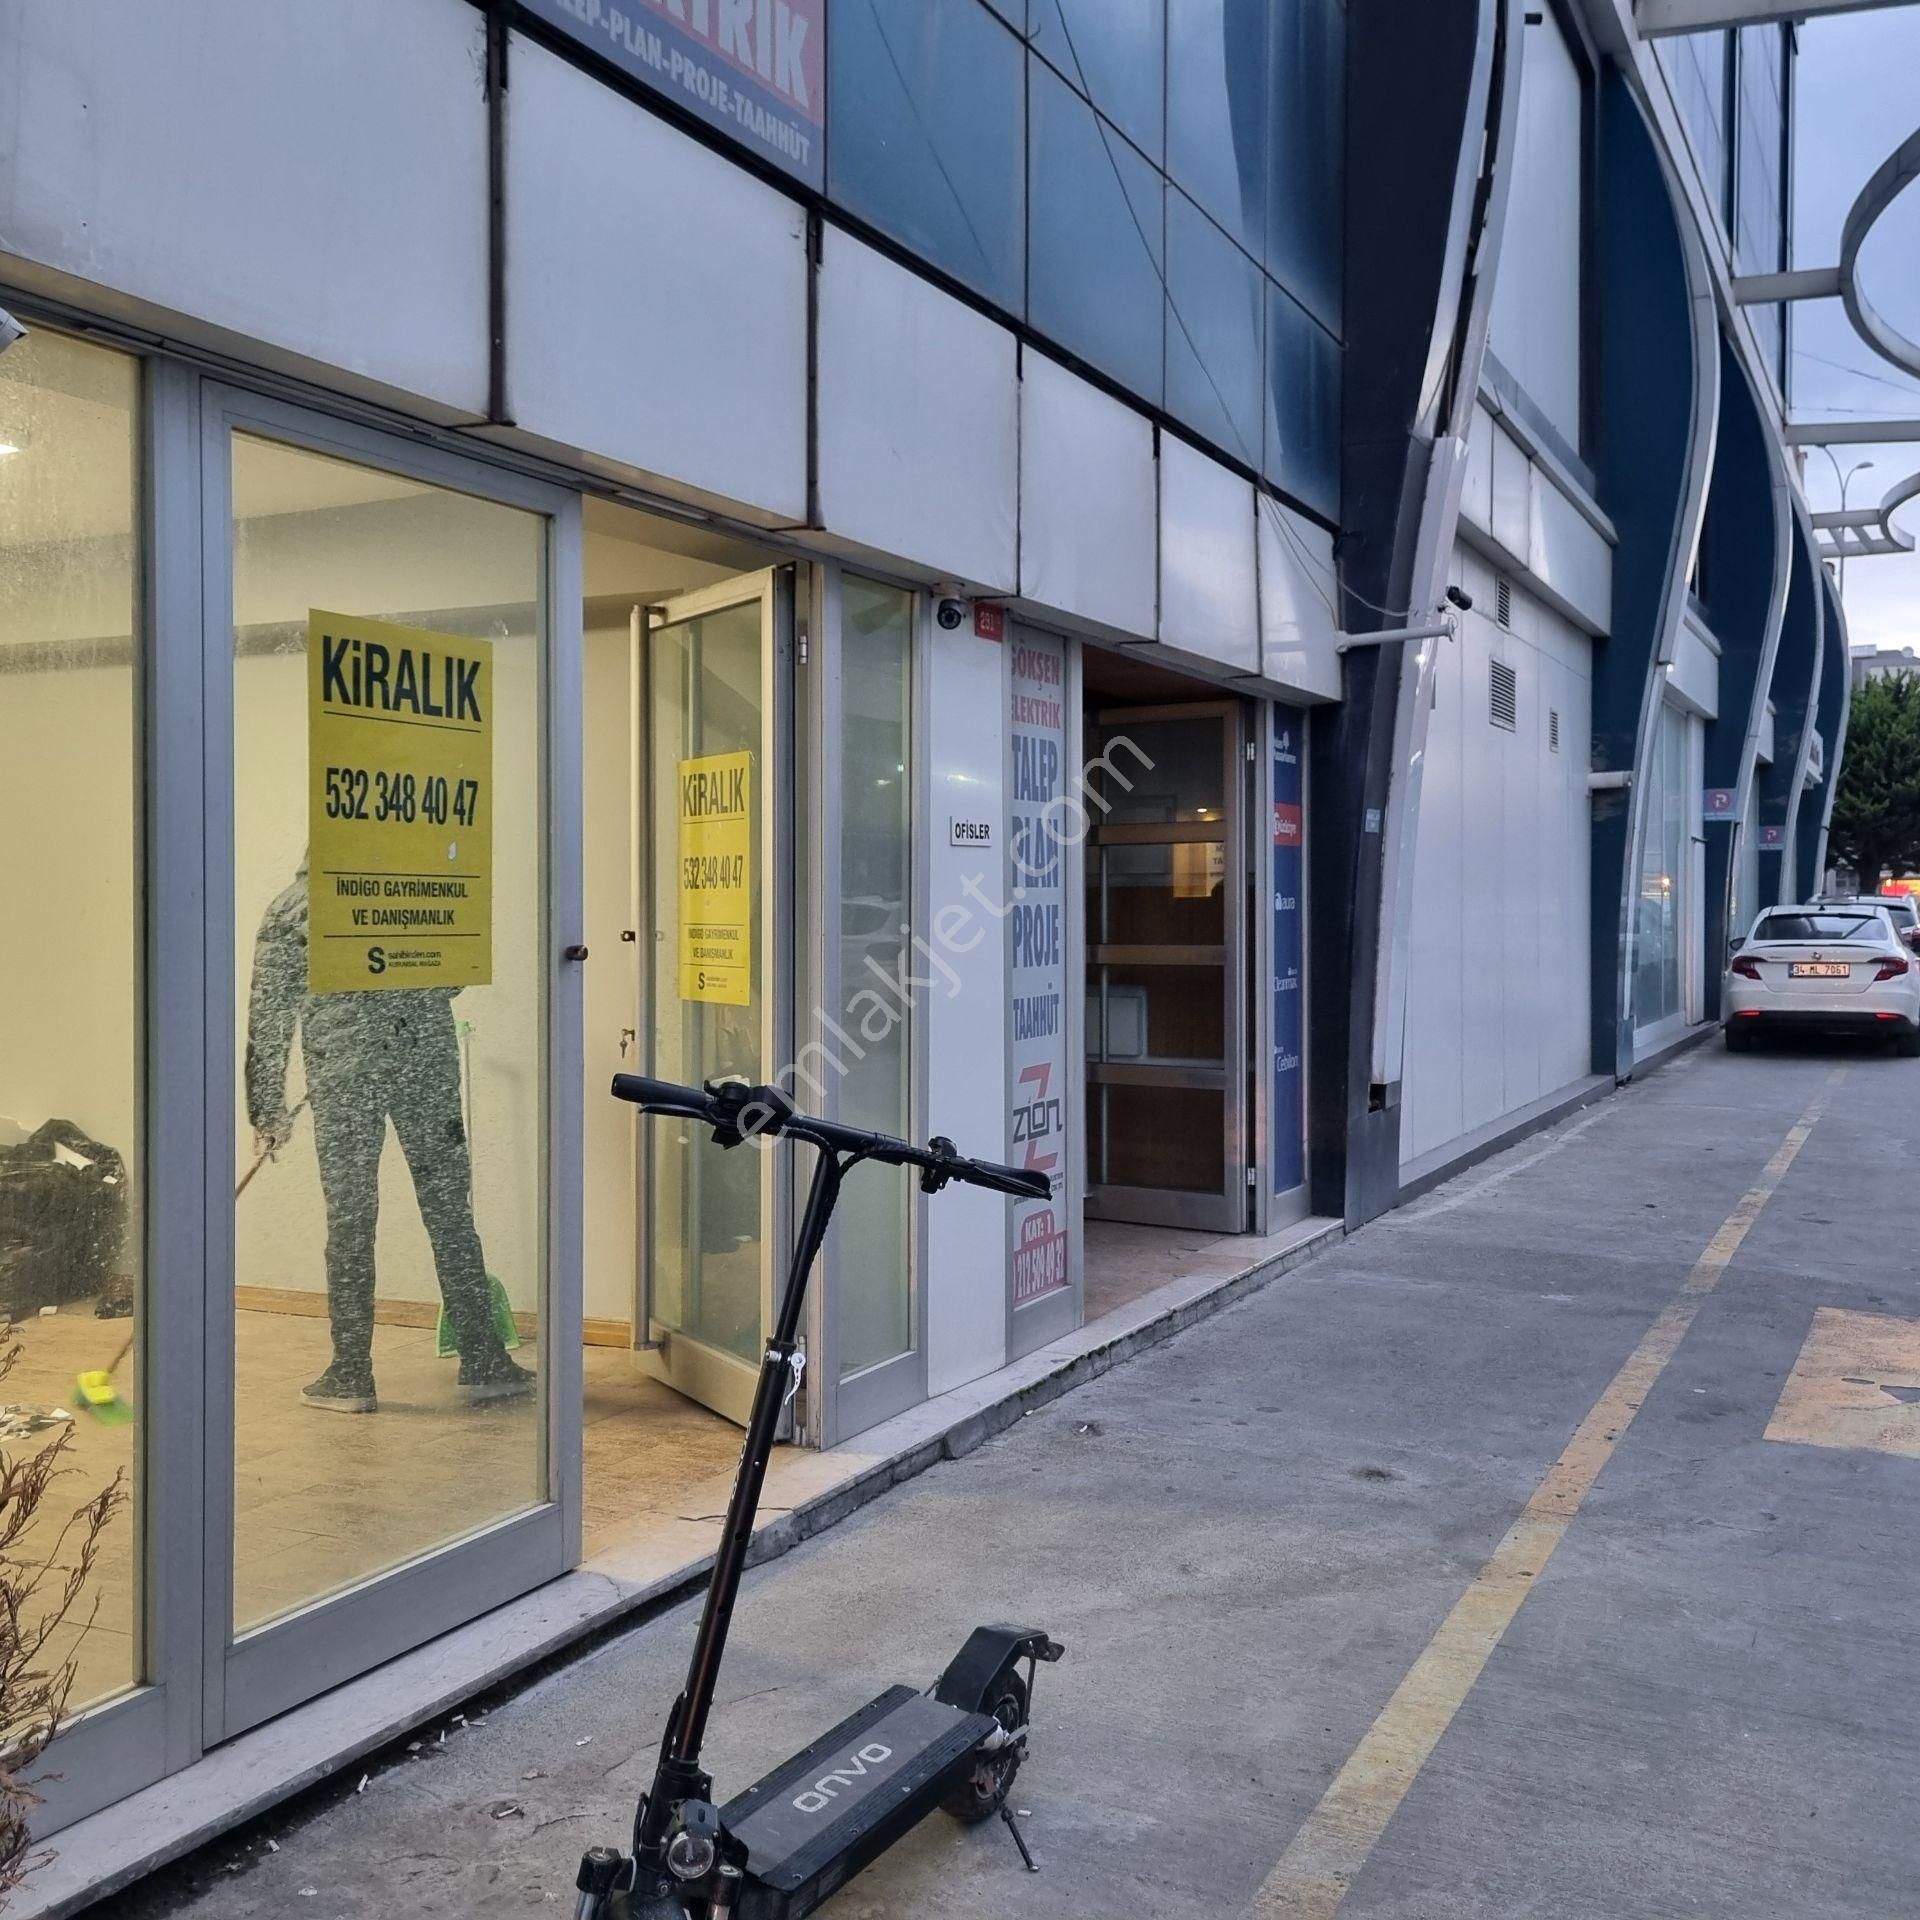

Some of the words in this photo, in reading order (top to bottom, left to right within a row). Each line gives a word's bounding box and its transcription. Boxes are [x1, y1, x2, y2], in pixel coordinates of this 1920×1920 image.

[1011, 694, 1061, 729] LEKTRİK
[1012, 733, 1058, 802] TALEP
[326, 767, 369, 819] 532
[375, 771, 416, 824] 348
[421, 775, 448, 826] 40
[453, 778, 479, 827] 47
[954, 819, 991, 840] OFİSLER
[1012, 815, 1059, 888] PLAN
[336, 876, 380, 897] İNDİGO
[384, 878, 469, 898] GAYRİMENKUL
[683, 857, 700, 890] 532
[701, 856, 718, 890] 348
[719, 855, 731, 890] 40
[732, 855, 744, 889] 47
[352, 909, 369, 926] VE
[371, 909, 456, 929] DANIŞMANLIK
[1012, 903, 1060, 968] PROJE
[1794, 965, 1805, 974] 34
[1809, 965, 1820, 975] ML
[1013, 982, 1060, 1041] TAAHHÜT
[1025, 1216, 1044, 1243] KAT:
